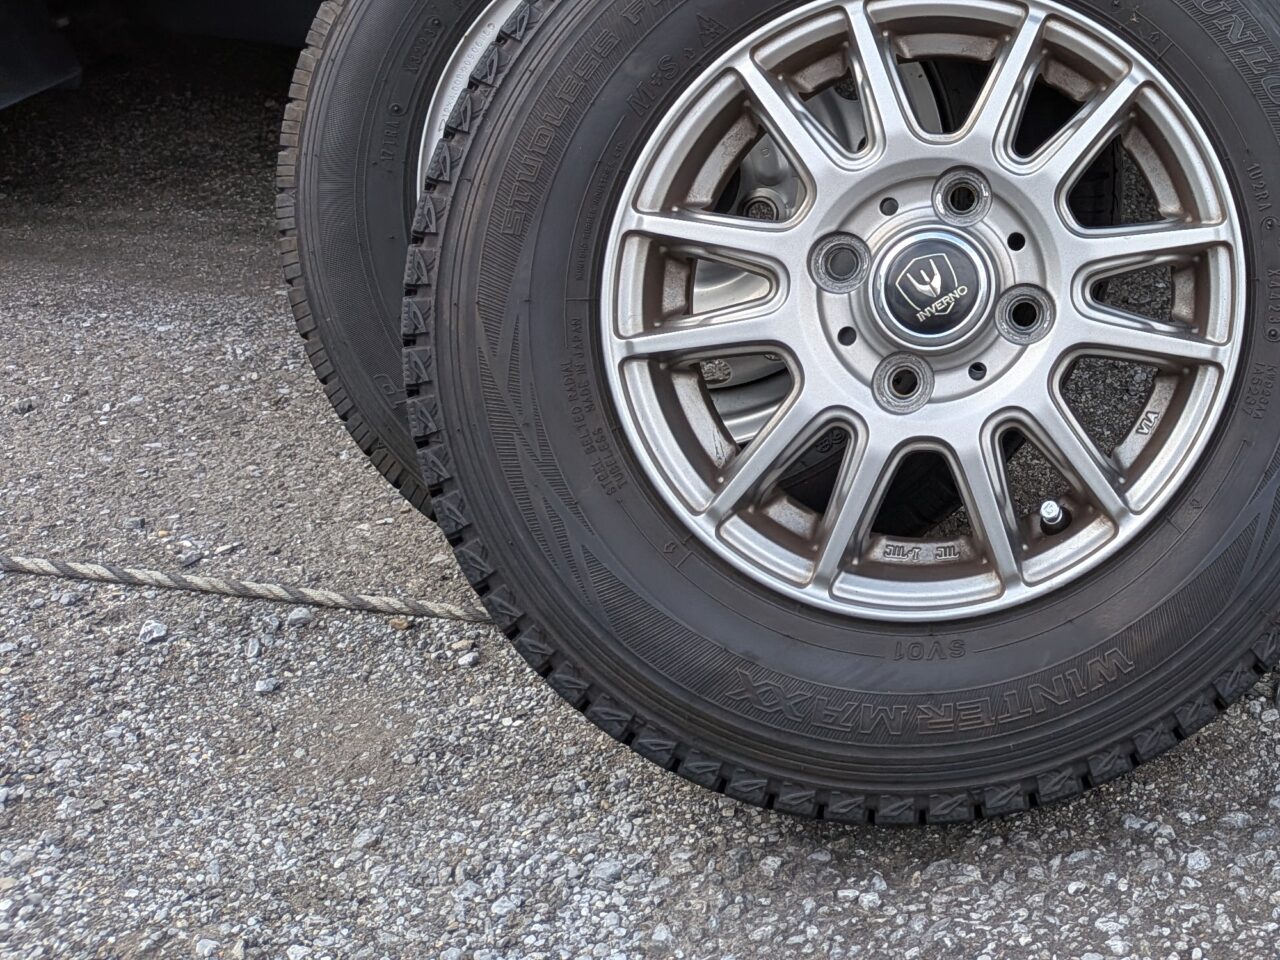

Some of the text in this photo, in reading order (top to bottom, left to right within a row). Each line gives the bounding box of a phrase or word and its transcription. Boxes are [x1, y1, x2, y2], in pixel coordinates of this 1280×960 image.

[625, 54, 682, 116] M+S
[501, 30, 619, 235] STUDLESS
[915, 285, 968, 322] INVERNO
[726, 646, 1135, 734] WINTER MAXX
